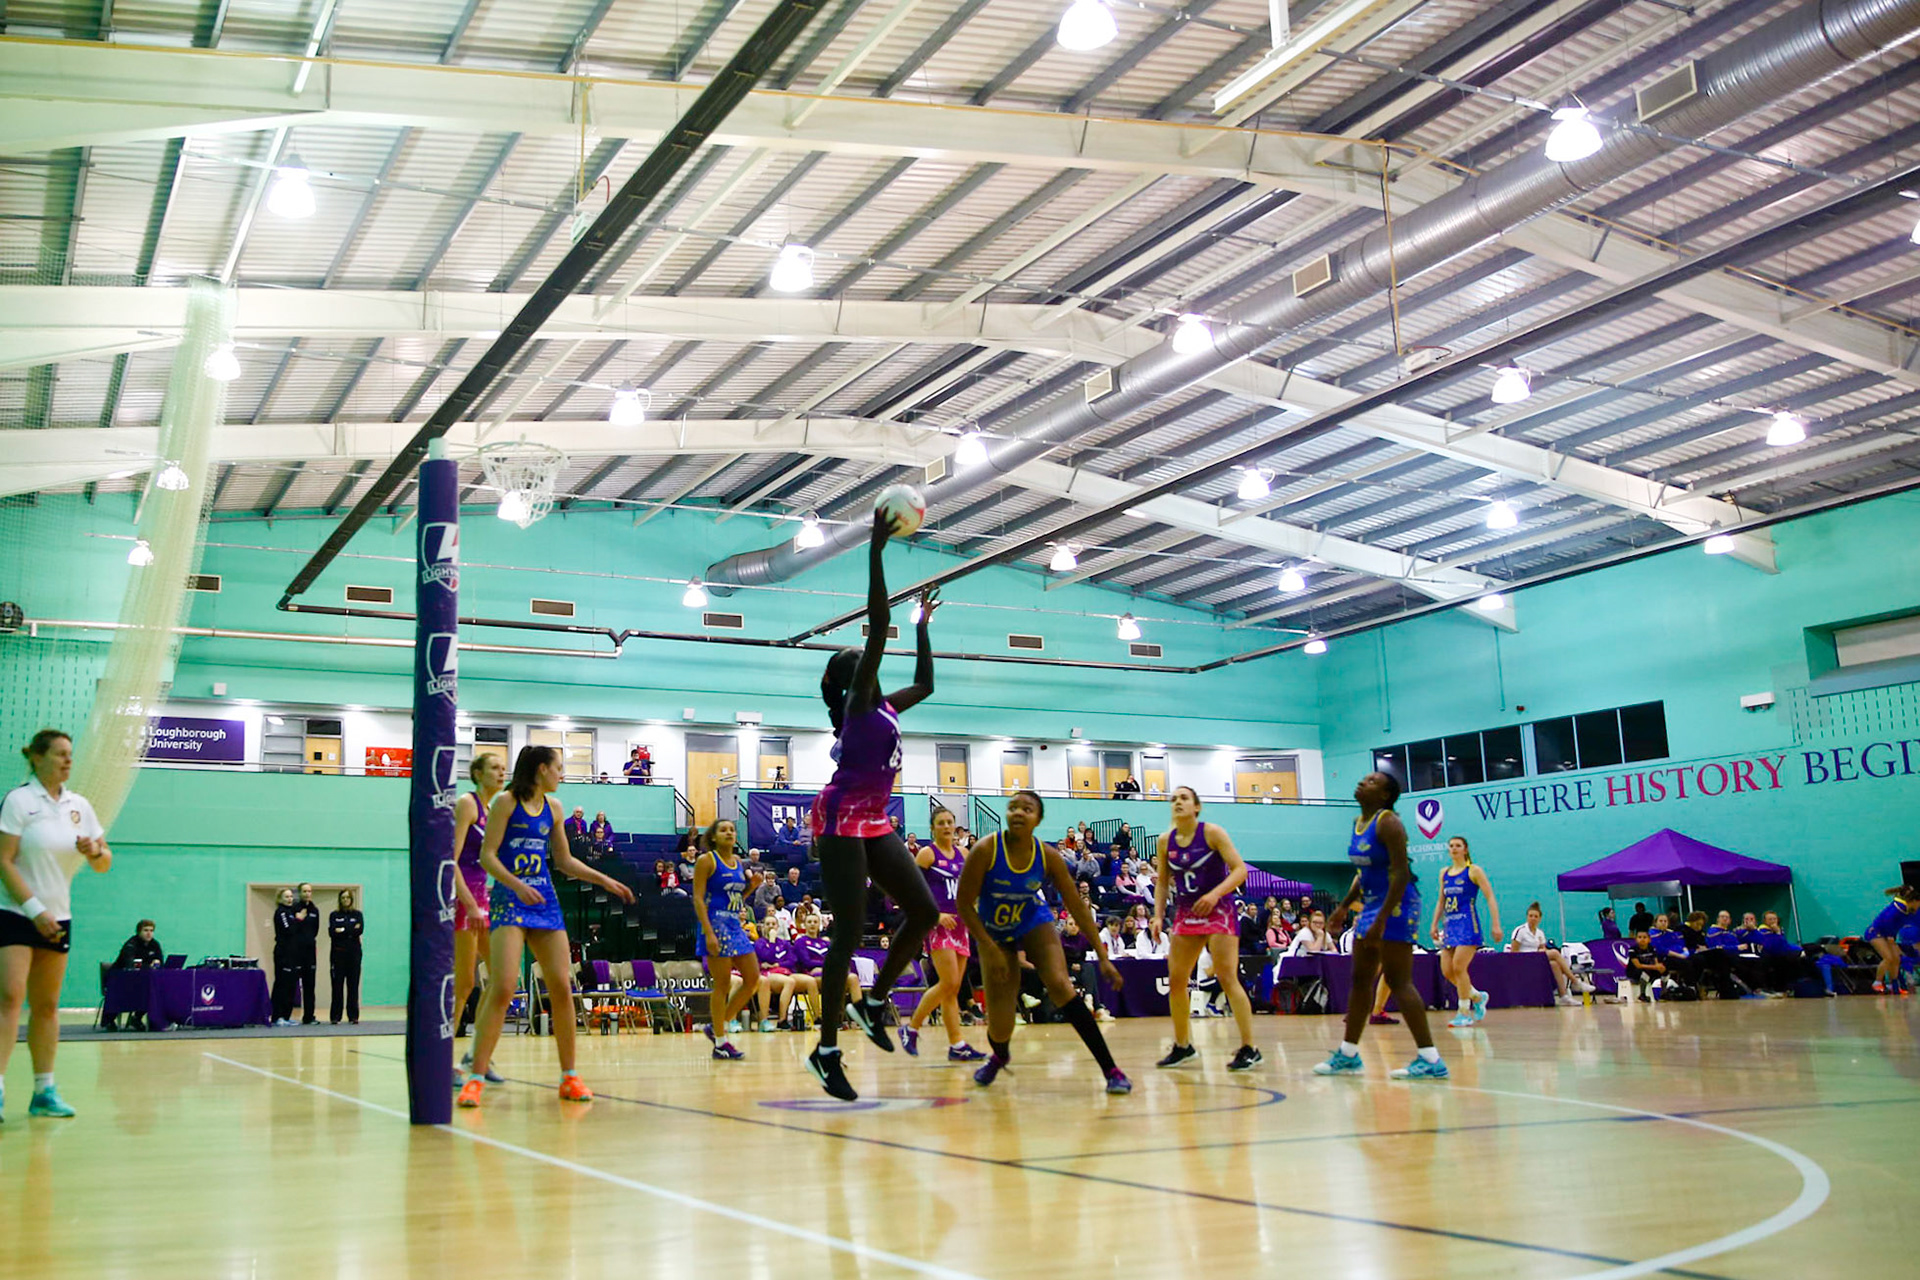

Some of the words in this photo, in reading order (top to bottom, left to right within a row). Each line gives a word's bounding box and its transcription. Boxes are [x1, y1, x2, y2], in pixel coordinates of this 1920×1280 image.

[148, 726, 227, 742] Loughborough
[148, 738, 203, 752] University
[1471, 779, 1596, 821] WHERE
[1605, 754, 1787, 807] HISTORY
[1800, 738, 1920, 785] BEGI
[512, 853, 542, 876] CD
[945, 878, 960, 900] W
[1184, 871, 1199, 892] C
[994, 902, 1027, 926] GK
[1445, 896, 1459, 912] GA
